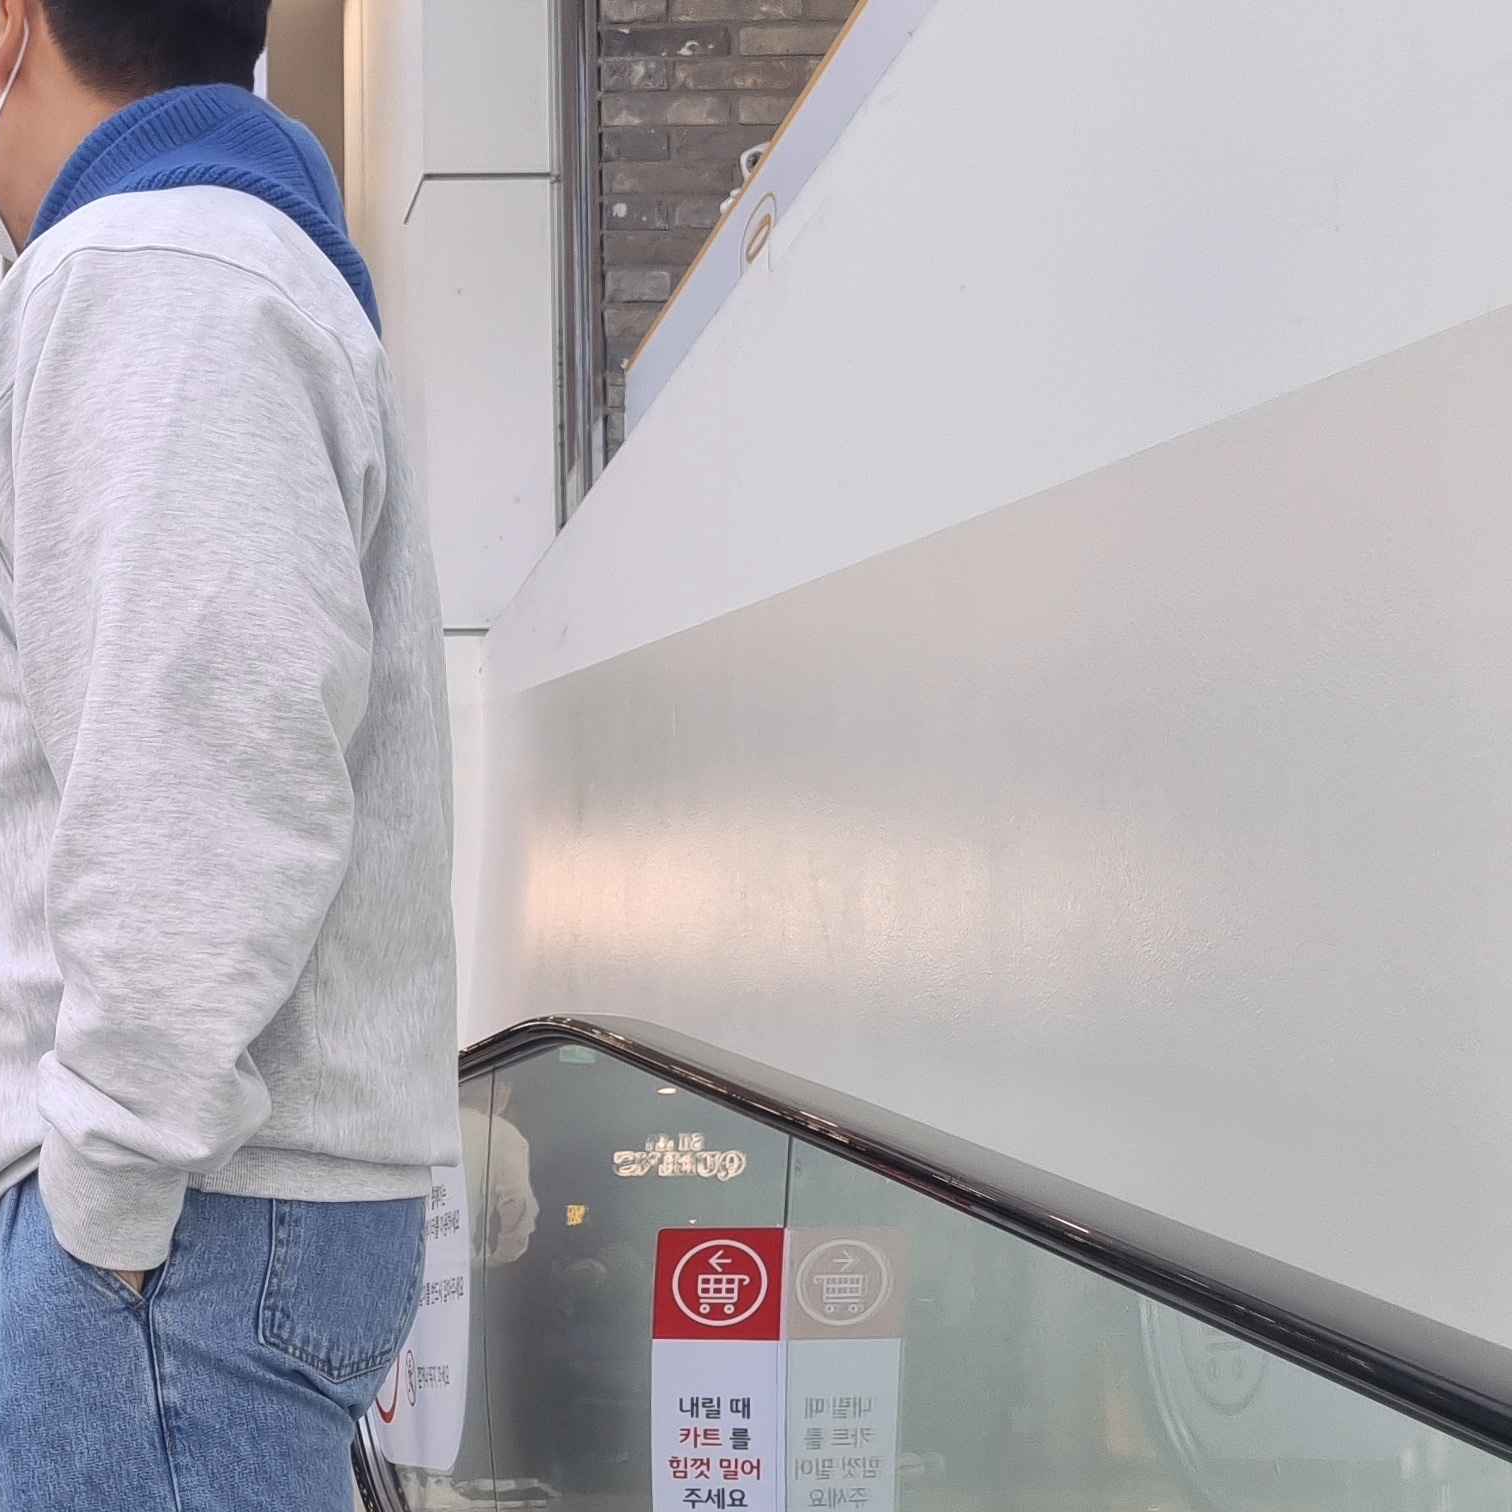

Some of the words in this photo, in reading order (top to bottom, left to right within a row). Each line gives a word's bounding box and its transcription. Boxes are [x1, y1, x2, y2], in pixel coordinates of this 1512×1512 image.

[678, 1396, 721, 1419] 내릴
[729, 1397, 751, 1419] 때
[678, 1426, 723, 1448] 카트
[729, 1427, 751, 1450] 를
[667, 1455, 711, 1480] 힘껏
[719, 1457, 761, 1481] 밀어
[682, 1487, 749, 1510] 주세요
